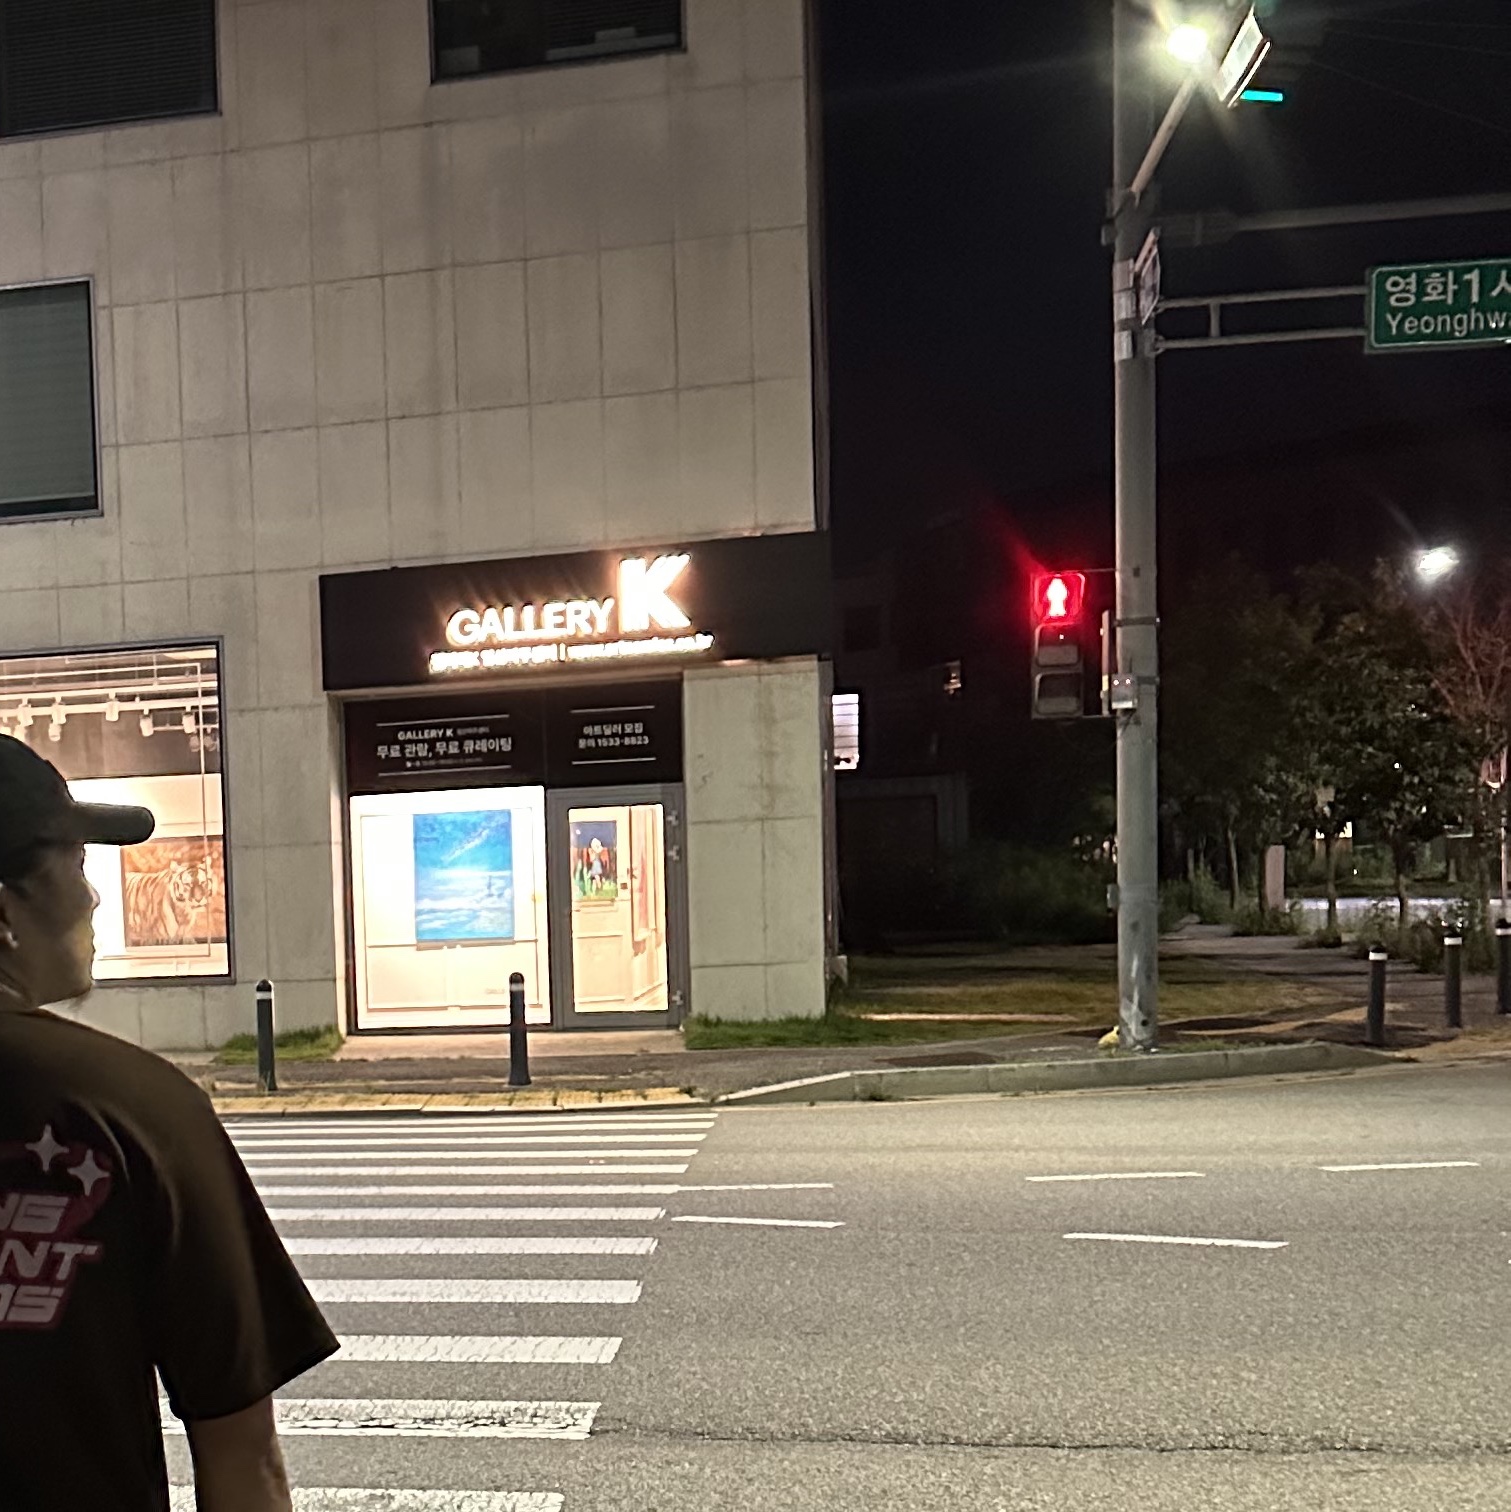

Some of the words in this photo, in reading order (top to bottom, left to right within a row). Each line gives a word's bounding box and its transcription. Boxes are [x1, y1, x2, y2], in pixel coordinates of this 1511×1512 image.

[1386, 307, 1511, 337] Yeonghw
[446, 597, 615, 647] GALLERY
[618, 554, 692, 634] K
[376, 744, 402, 759] 무료
[435, 740, 461, 756] 무료
[462, 736, 512, 754] 큐레이팅
[397, 728, 444, 741] GALLERY
[445, 728, 455, 738] K
